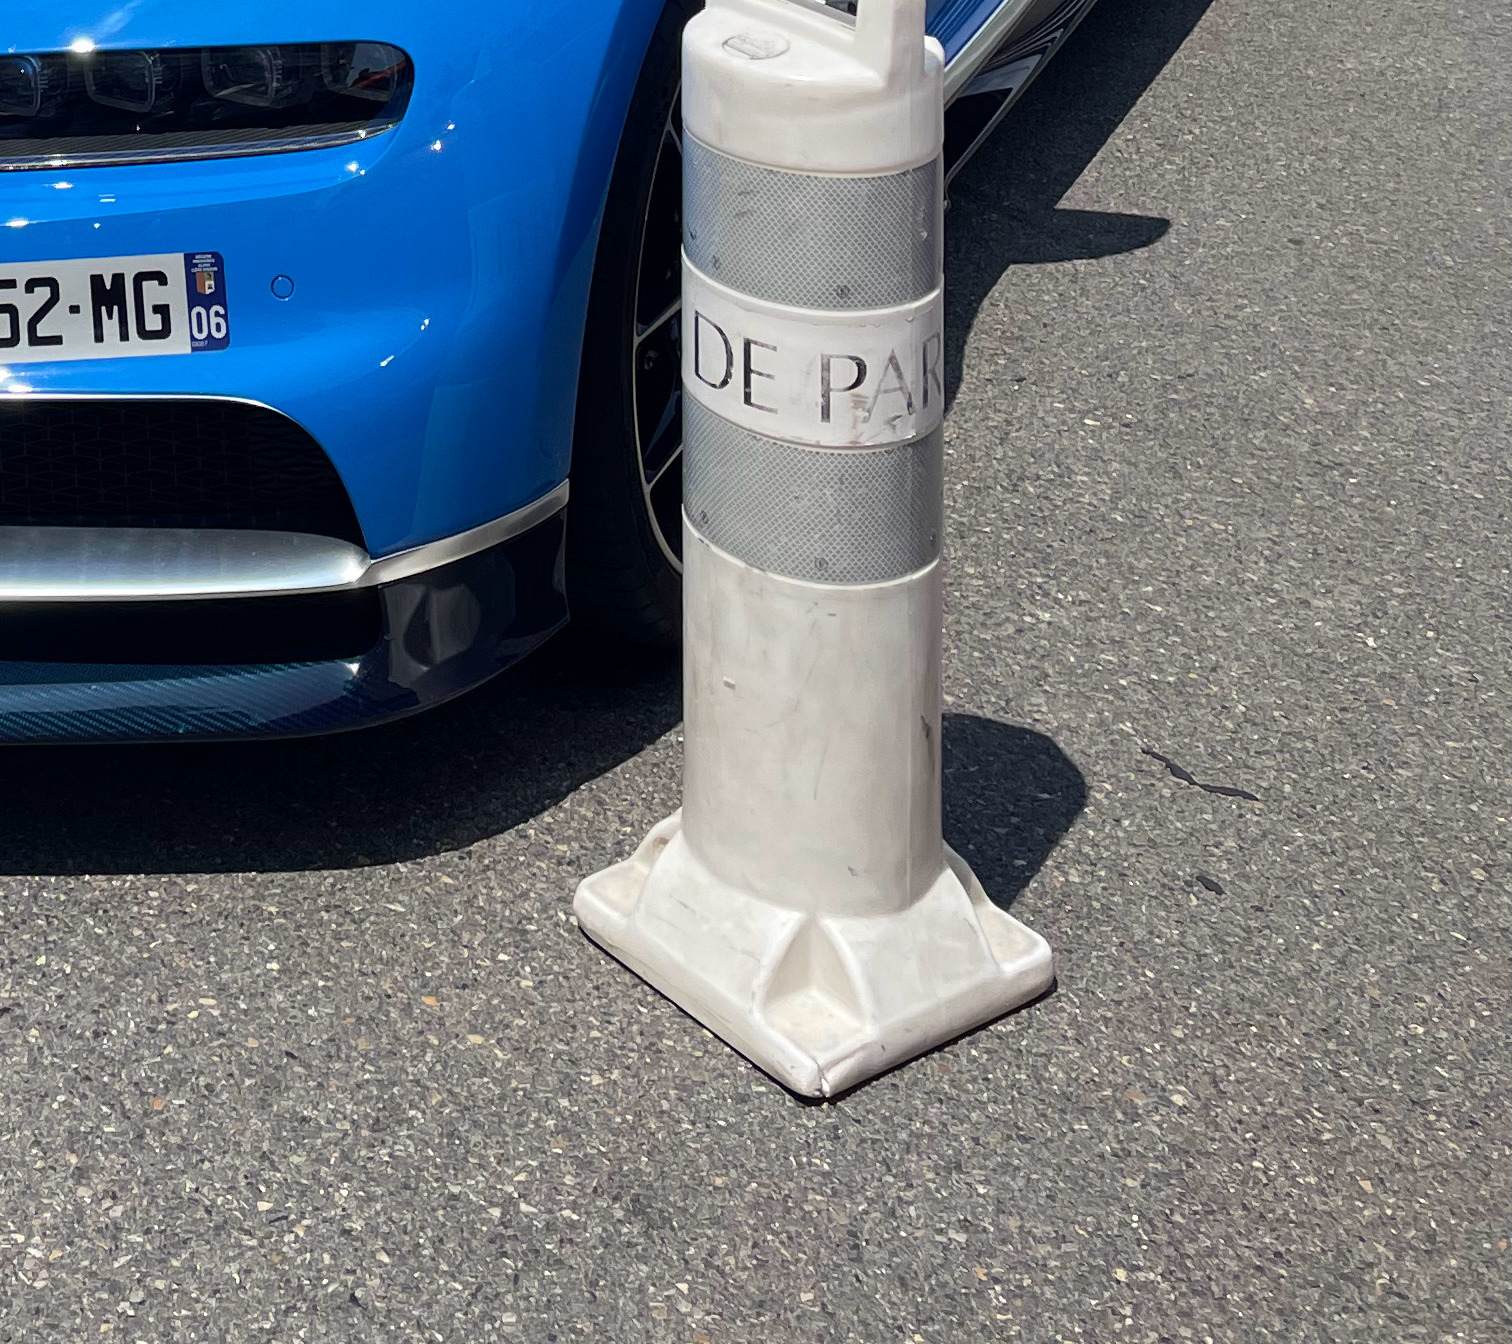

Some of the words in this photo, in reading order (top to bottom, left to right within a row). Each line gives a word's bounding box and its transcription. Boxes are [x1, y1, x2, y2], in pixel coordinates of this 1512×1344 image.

[190, 304, 227, 341] 06
[693, 310, 778, 415] DE
[820, 330, 943, 424] PAR
